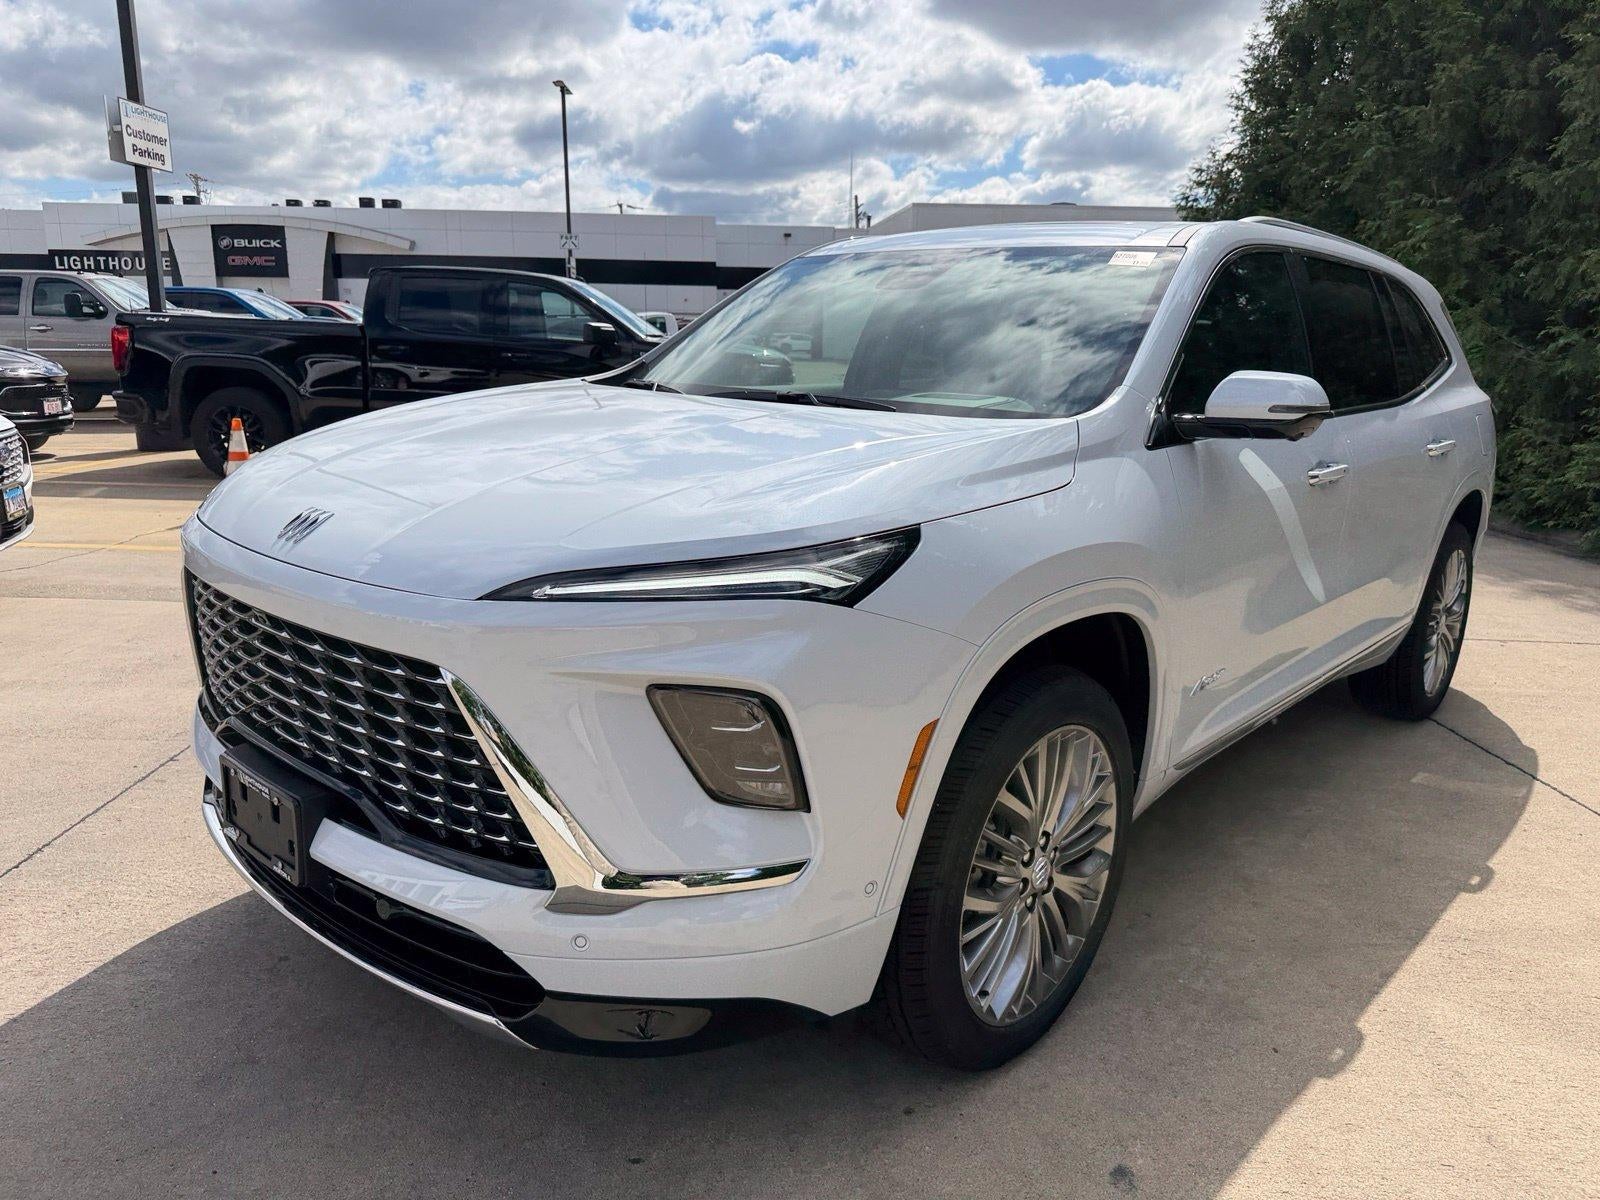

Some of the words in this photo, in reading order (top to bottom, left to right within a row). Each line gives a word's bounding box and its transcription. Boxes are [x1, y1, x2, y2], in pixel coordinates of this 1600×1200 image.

[125, 124, 167, 147] Customer
[131, 143, 166, 166] Parking
[233, 238, 282, 248] BUICK
[54, 255, 171, 271] LIGHTHOUE
[227, 255, 276, 266] GMC
